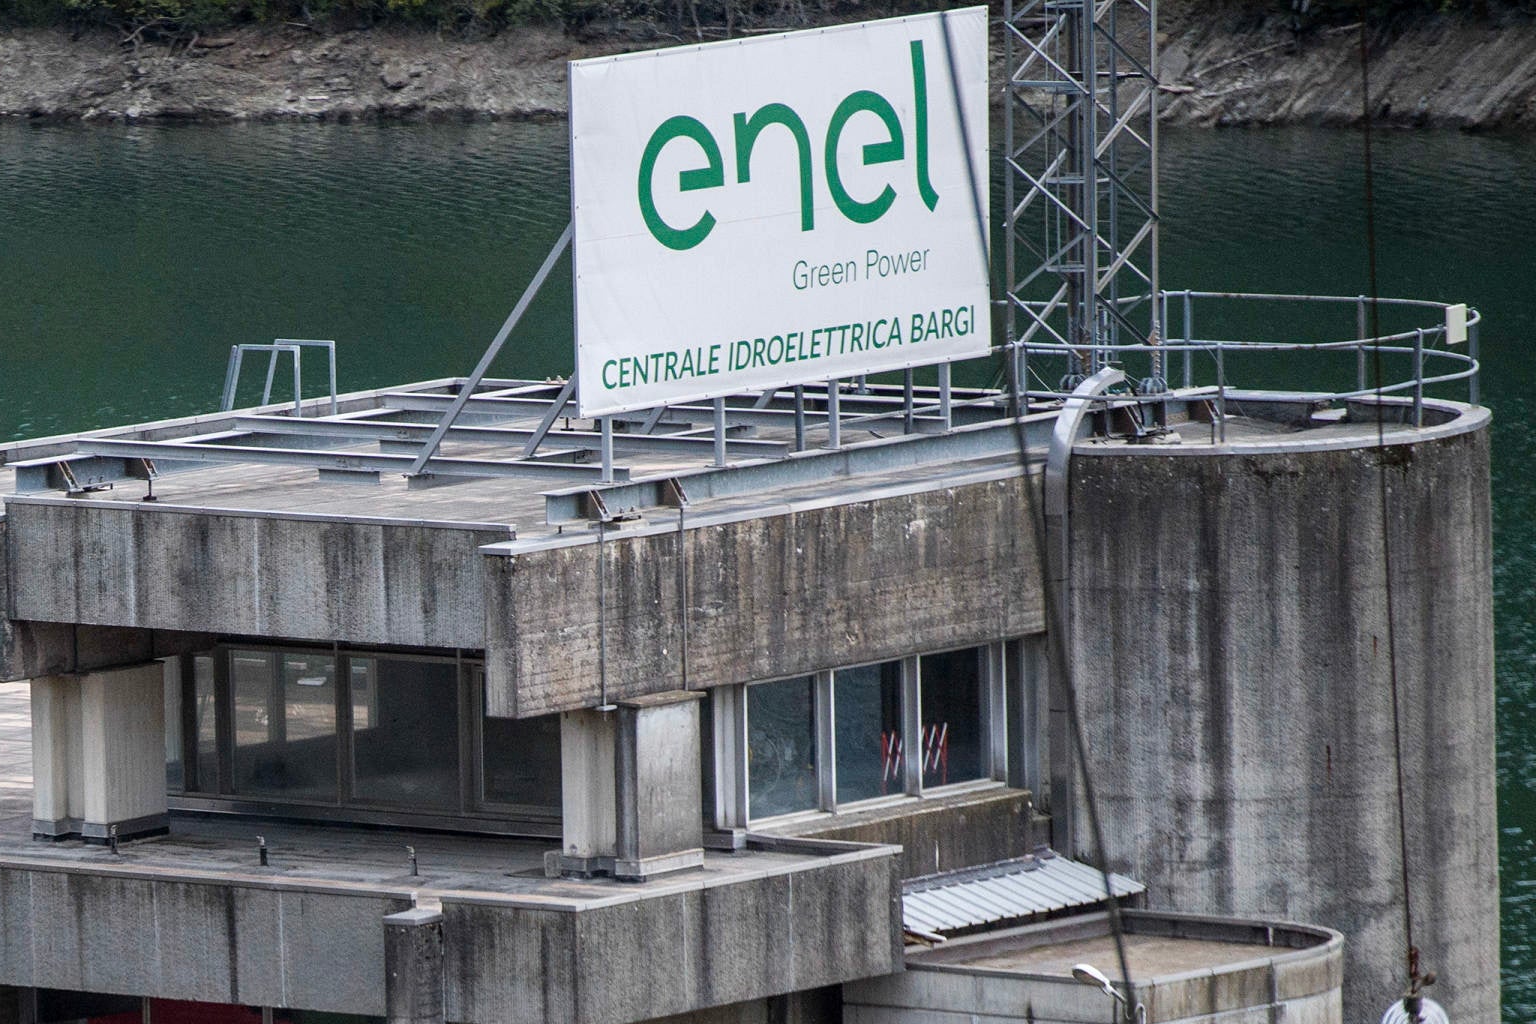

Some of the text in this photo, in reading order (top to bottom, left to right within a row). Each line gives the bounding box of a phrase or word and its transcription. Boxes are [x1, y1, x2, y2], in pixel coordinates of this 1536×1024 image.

[637, 40, 939, 251] enel
[793, 248, 930, 290] Green Power
[602, 305, 975, 390] CENTRALE IDROELETTRICA BARGI
